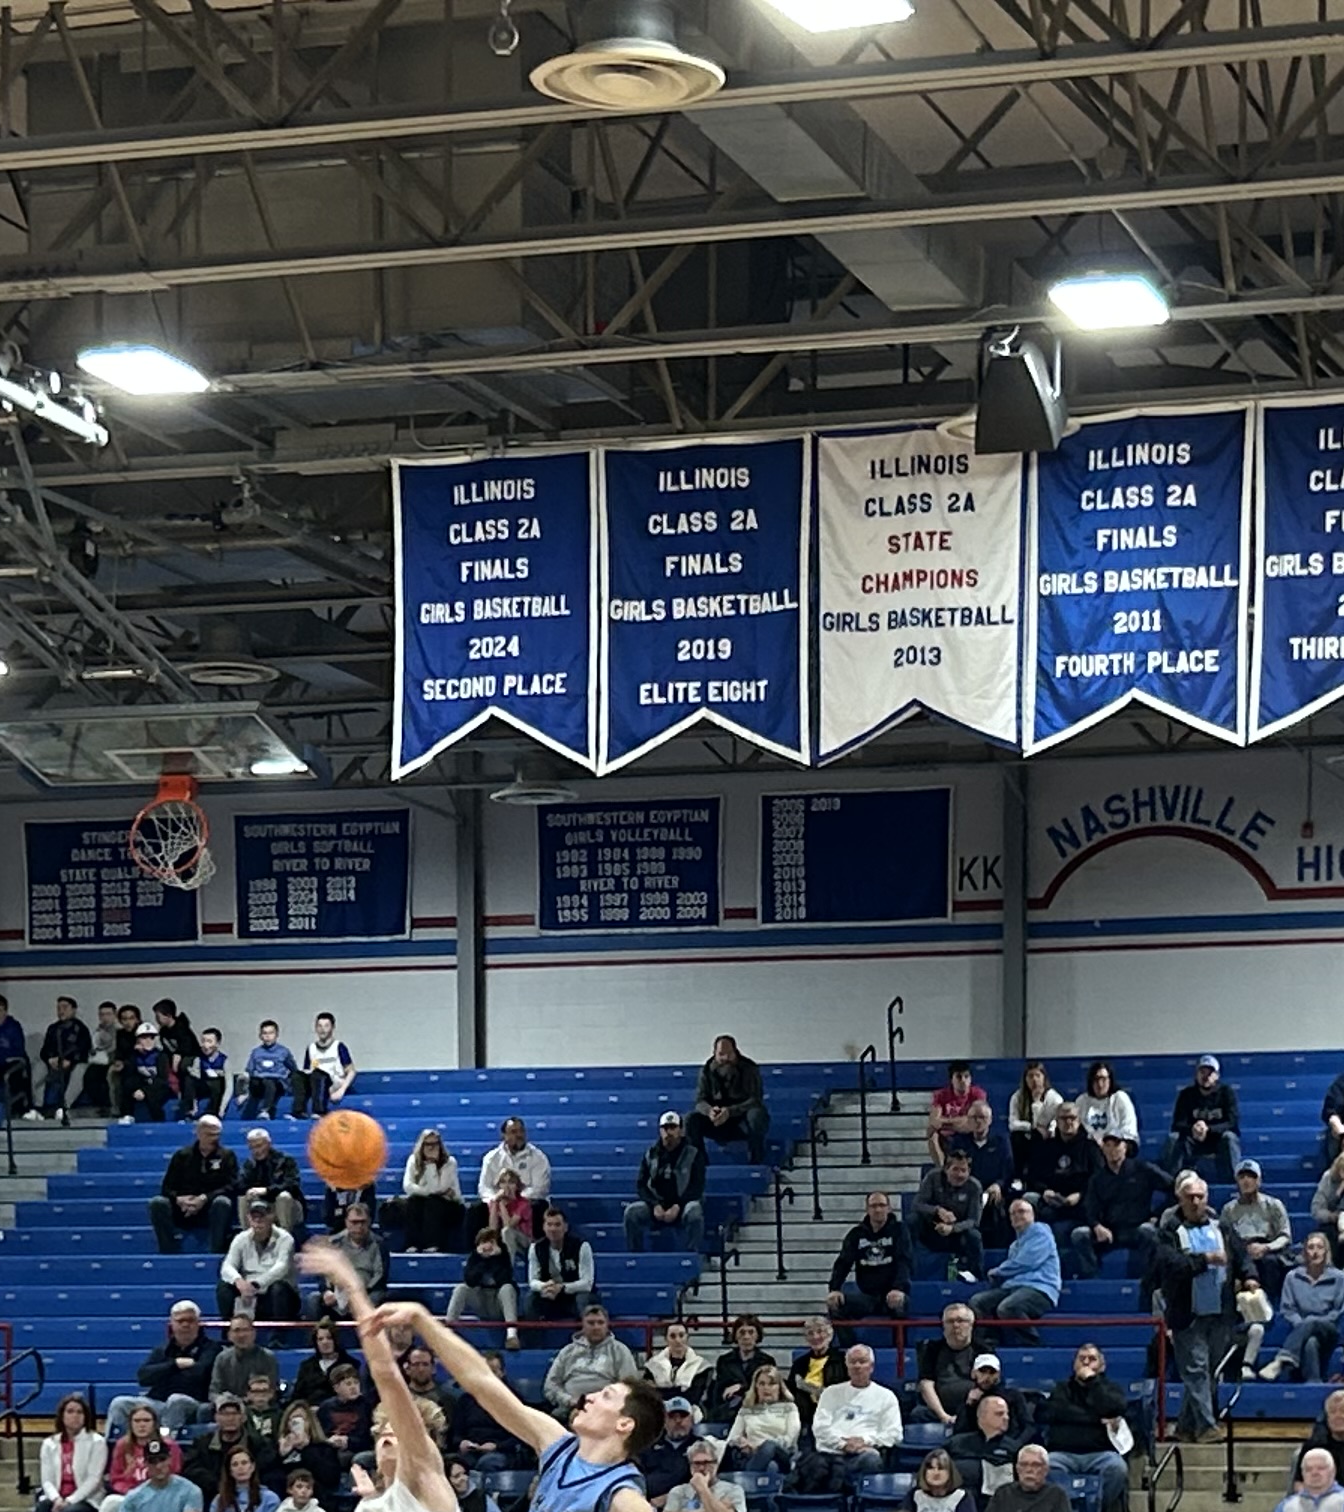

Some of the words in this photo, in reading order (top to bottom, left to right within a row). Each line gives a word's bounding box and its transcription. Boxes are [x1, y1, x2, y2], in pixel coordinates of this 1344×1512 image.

[869, 452, 969, 480] ILLINOIS
[1088, 442, 1192, 470] ILLINOIS
[453, 478, 536, 505] ILLINOIS
[658, 466, 750, 492] ILLINOIS
[864, 491, 935, 518] CLASS
[947, 490, 976, 514] 2A
[1081, 484, 1154, 512] CLASS
[1166, 483, 1198, 507] 2A
[449, 517, 510, 544] CLASS
[517, 516, 541, 540] 2A
[648, 509, 720, 535] CLASS
[730, 508, 759, 532] 2A
[888, 529, 953, 555] STATE
[1096, 525, 1178, 550] FINALS
[461, 557, 529, 581] FINALS
[665, 552, 743, 578] FINALS
[1265, 552, 1323, 577] GIRLS
[861, 566, 979, 594] CHAMPIONS
[1039, 570, 1097, 596] GIRLS
[1103, 564, 1239, 593] BASKETBALL
[420, 599, 468, 625] GIRLS
[473, 594, 570, 620] BASKETBALL
[610, 595, 666, 622] GIRLS
[671, 589, 798, 618] BASKETBALL
[822, 609, 879, 633] GIRLS
[887, 604, 1014, 630] BASKETBALL
[1113, 611, 1162, 634] 2011
[468, 636, 520, 660] 2024
[677, 637, 732, 661] 2019
[892, 645, 942, 670] 2013
[1055, 653, 1136, 679] FOURTH
[1148, 650, 1219, 675] PLACE
[422, 675, 497, 702] SECOND
[503, 672, 567, 698] PLACE
[639, 679, 700, 704] ELITE
[706, 679, 767, 703] EIGHT
[1045, 784, 1276, 860] NASHVILLE
